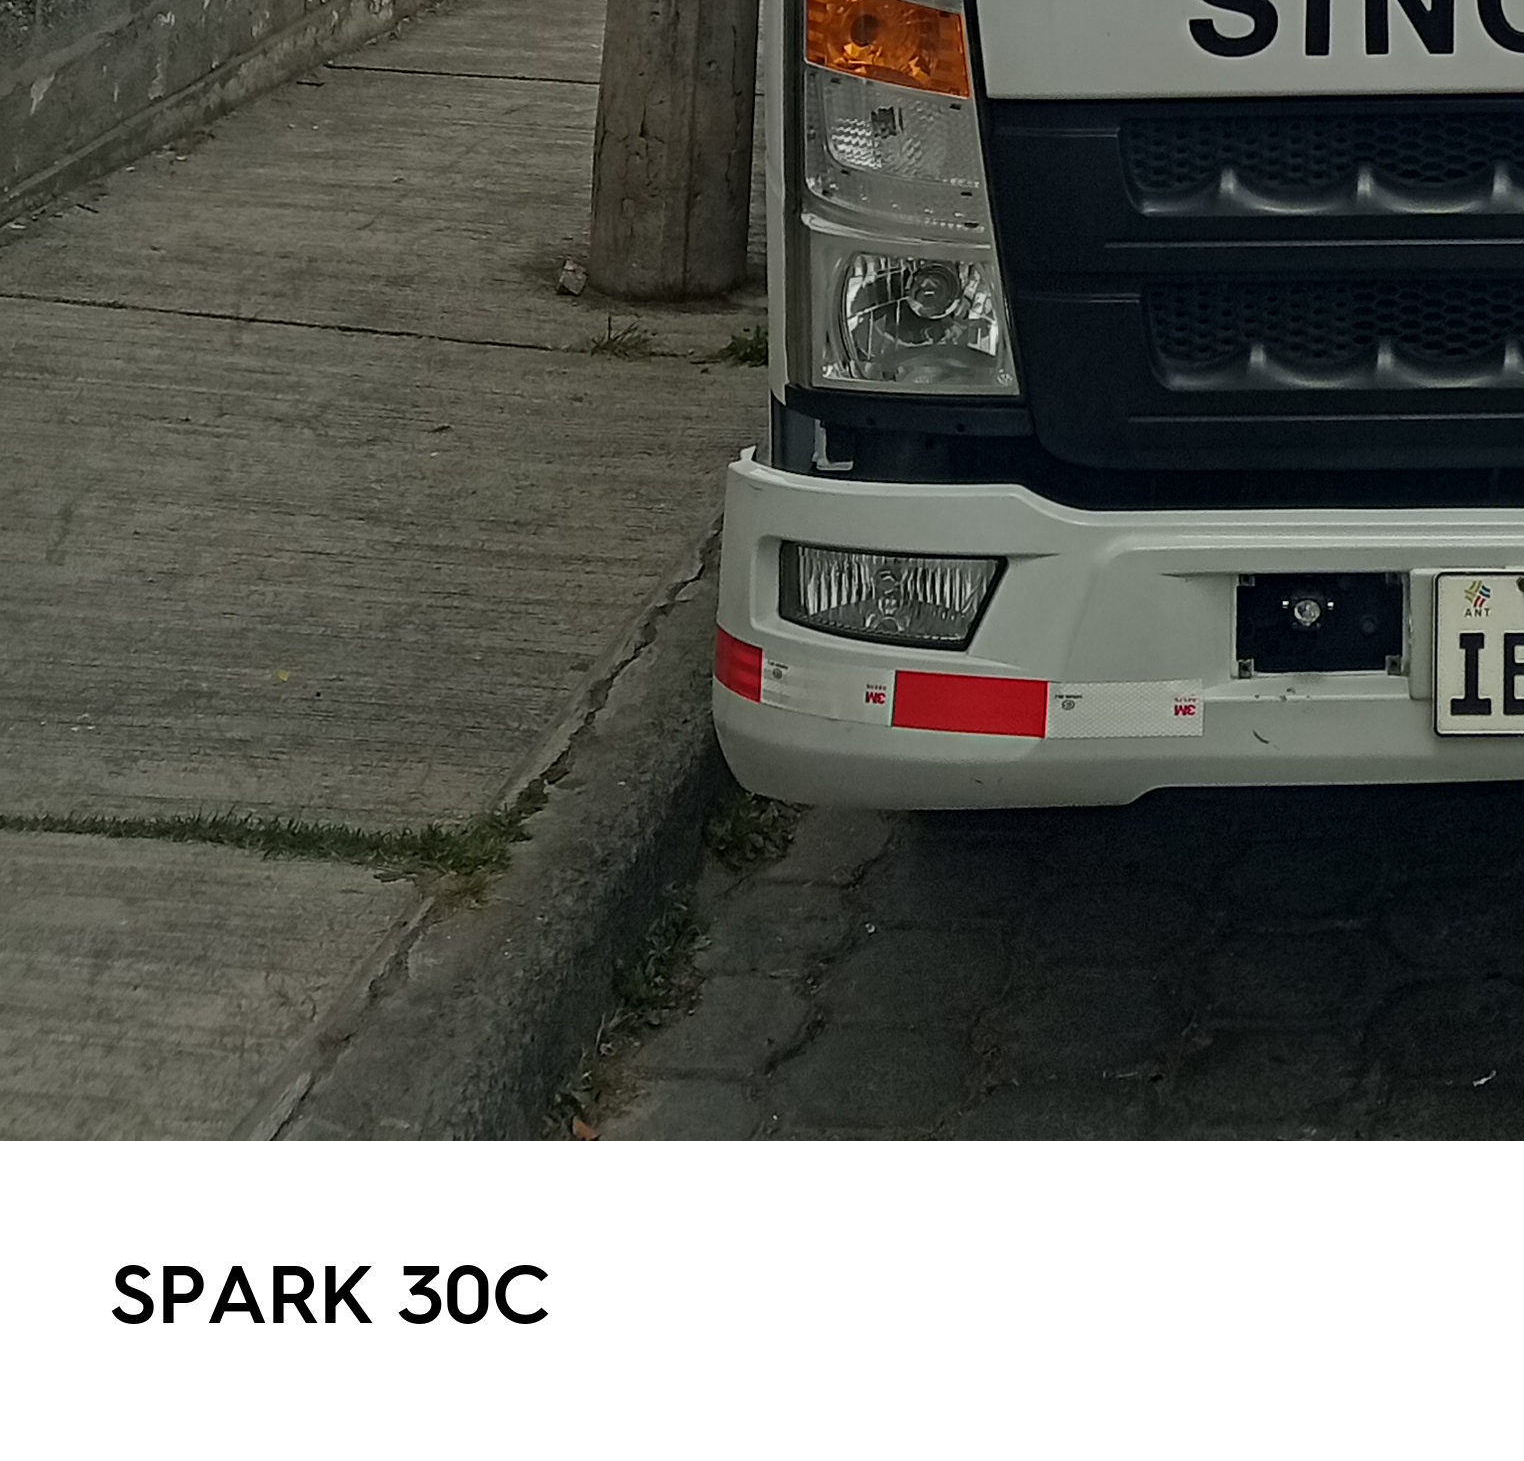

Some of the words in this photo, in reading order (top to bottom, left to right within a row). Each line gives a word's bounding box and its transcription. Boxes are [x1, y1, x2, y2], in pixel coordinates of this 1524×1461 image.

[1464, 607, 1492, 618] ANT
[865, 691, 887, 705] 3M
[1174, 704, 1197, 716] 3M
